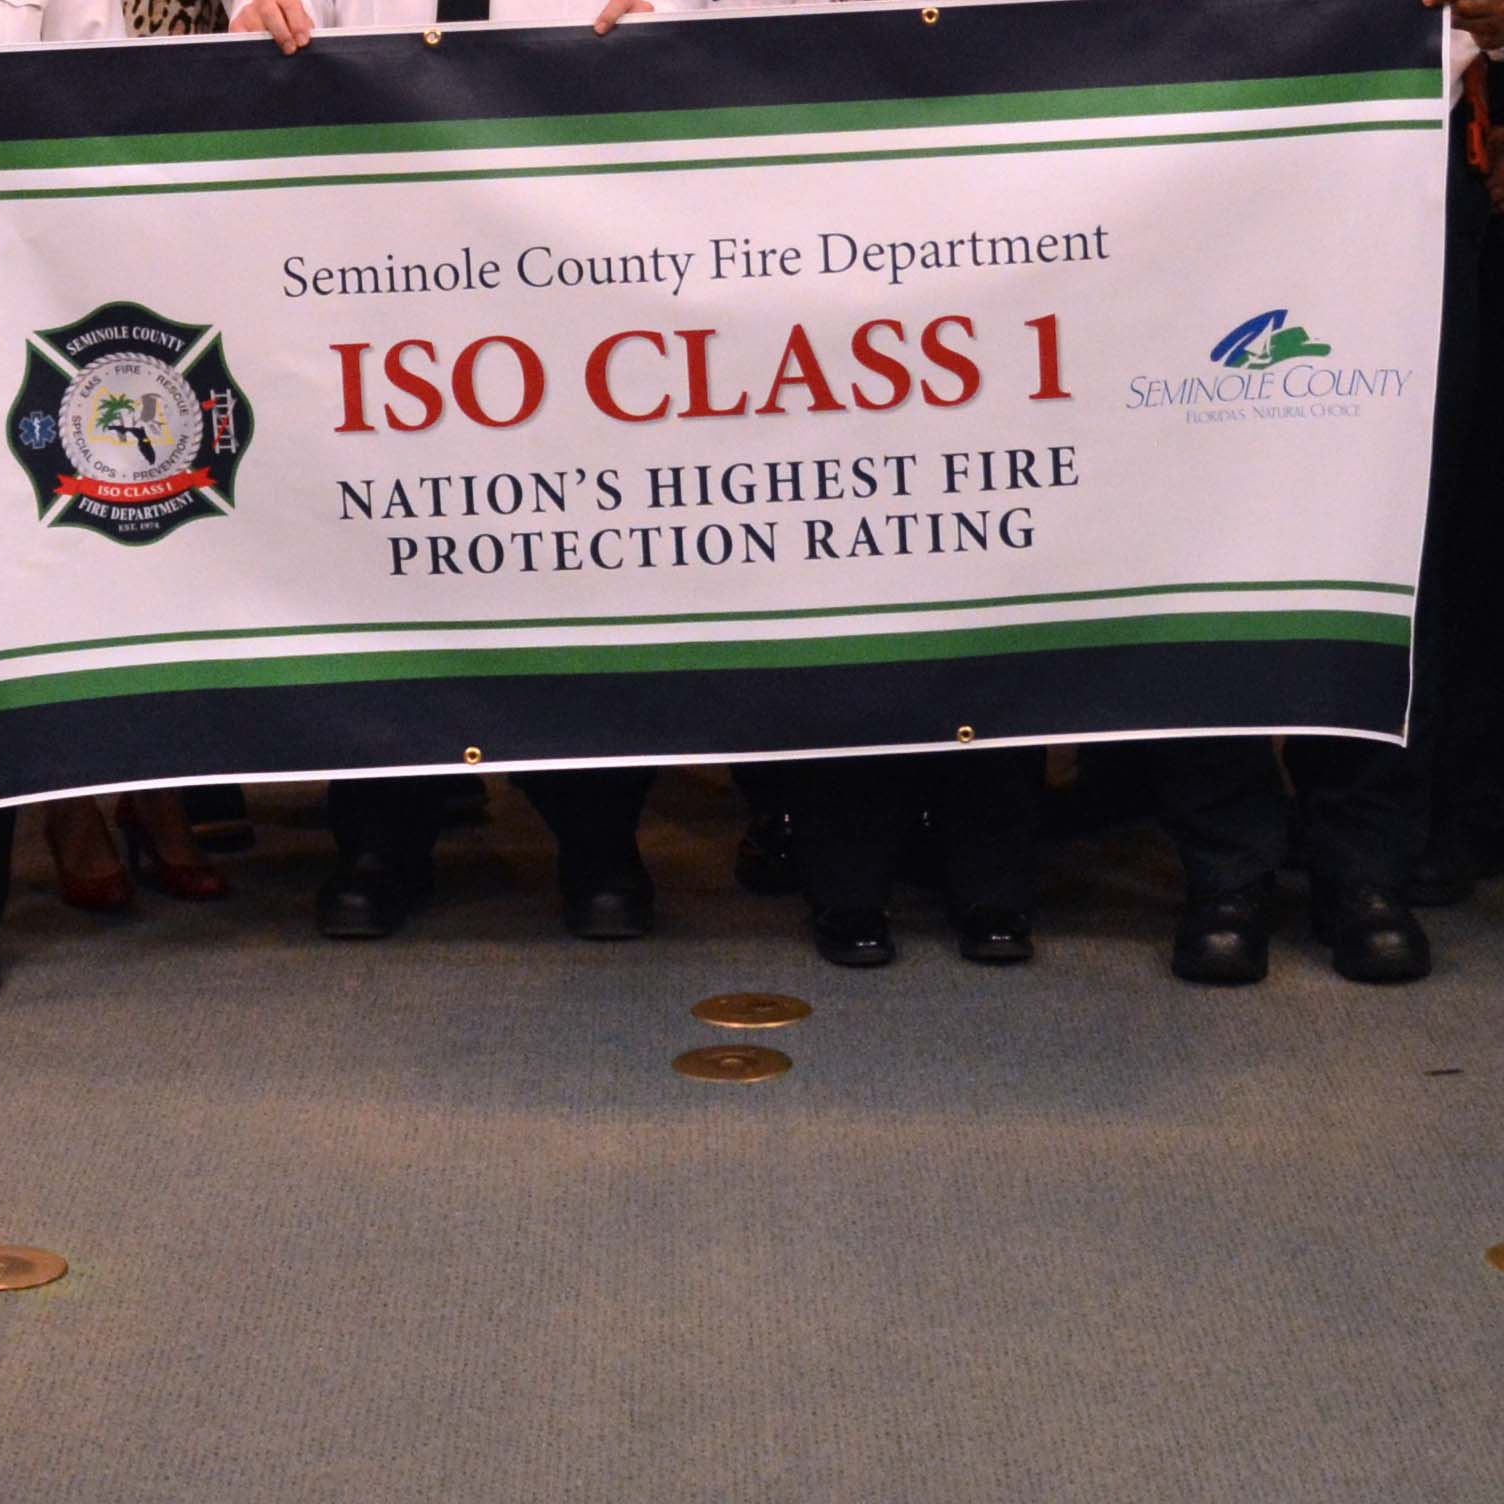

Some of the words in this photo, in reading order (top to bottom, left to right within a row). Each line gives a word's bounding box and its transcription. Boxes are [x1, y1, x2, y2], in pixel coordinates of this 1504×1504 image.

[283, 248, 501, 298] Seminole
[517, 246, 695, 297] County
[710, 237, 802, 280] Fire
[819, 223, 1110, 284] Department
[66, 325, 130, 356] SEMINOLE
[132, 326, 185, 353] COUNTY
[80, 376, 102, 399] EMS
[114, 365, 141, 376] FIRE
[156, 375, 190, 417] RESCUE
[330, 334, 546, 434] ISO
[584, 314, 982, 423] CLASS
[1025, 313, 1073, 402] 1
[1126, 372, 1274, 409] SEMINOLE
[1283, 364, 1414, 399] COUNTY
[71, 414, 93, 464] SPECIAL
[93, 460, 117, 479] OPS
[132, 434, 190, 482] PREVENTION
[78, 497, 109, 519] FIRE
[110, 490, 195, 521] DEPARTMENT
[97, 484, 121, 497] ISO
[123, 484, 164, 498] CLASS
[337, 468, 623, 520] NATION'S
[646, 454, 918, 508] HIGHEST
[942, 445, 1081, 494] FIRE
[389, 519, 780, 576] PROTECTION
[804, 507, 1036, 560] RATING
